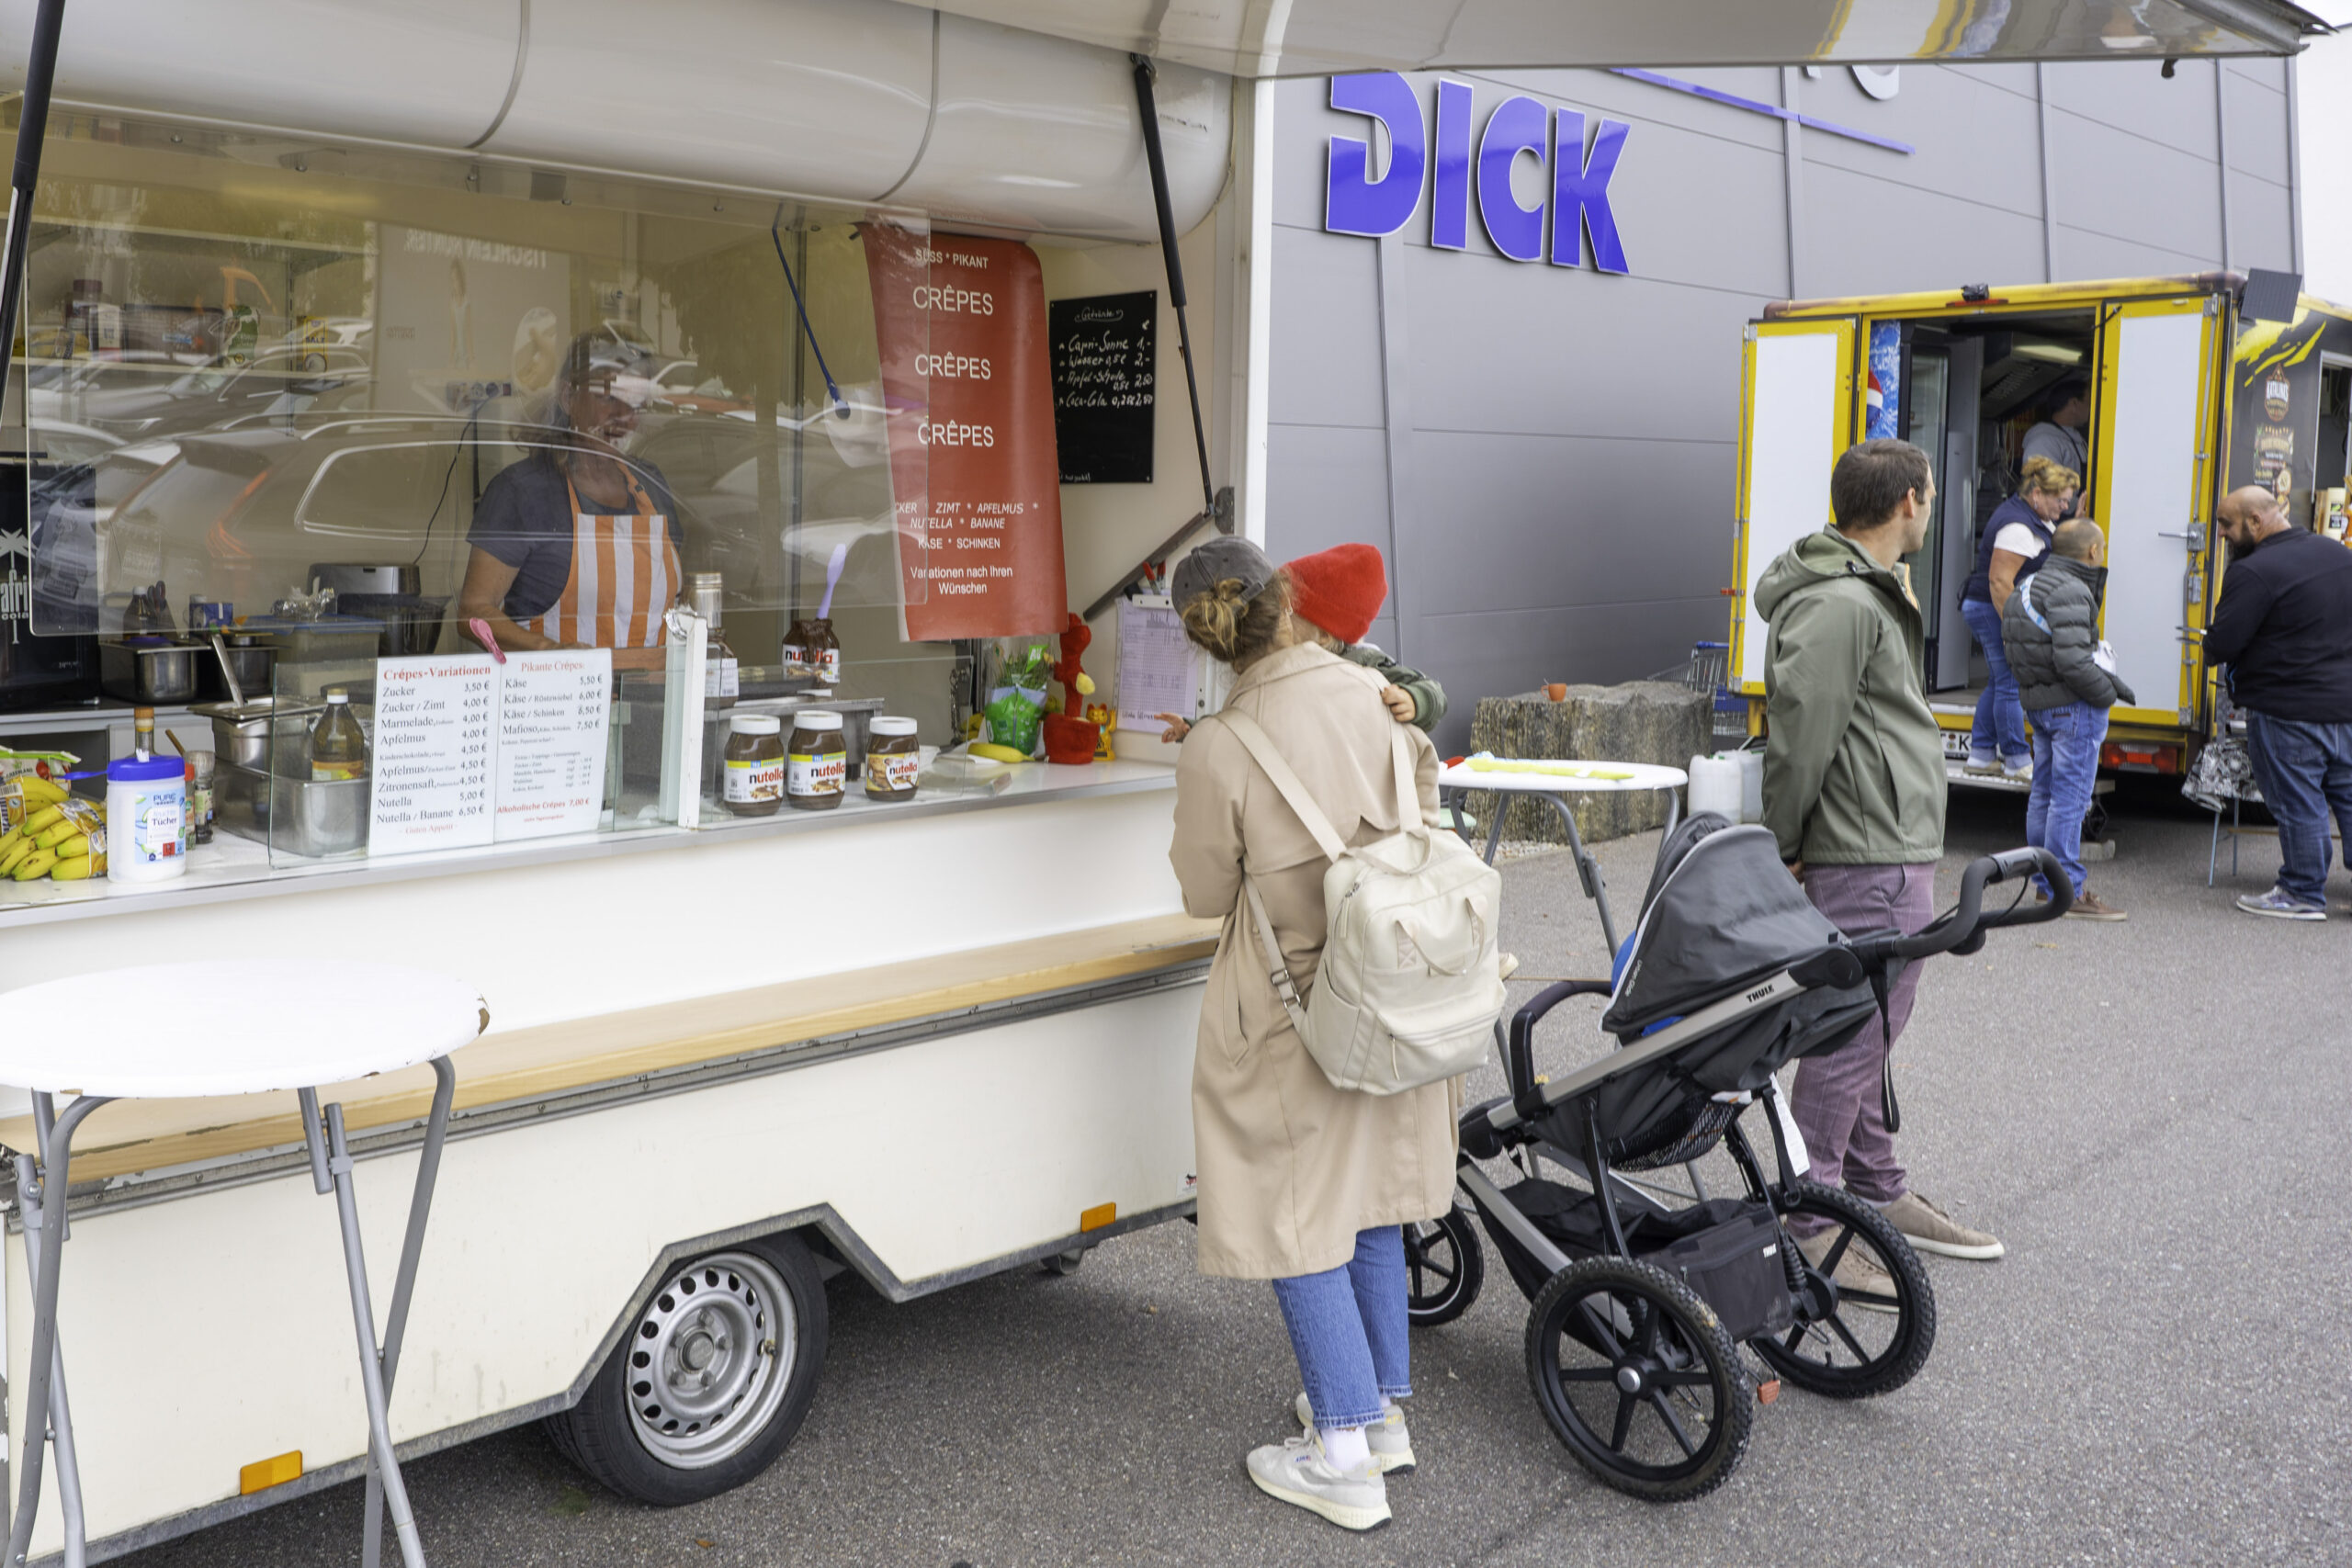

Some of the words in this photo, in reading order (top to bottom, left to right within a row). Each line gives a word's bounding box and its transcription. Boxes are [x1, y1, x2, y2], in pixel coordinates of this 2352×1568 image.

[1325, 71, 1631, 276] DICK
[953, 253, 989, 269] PIKANT
[913, 284, 993, 316] CRÊPES
[1069, 330, 1129, 356] Capri-Sonne
[915, 351, 991, 380] CRÊPES
[1066, 390, 1108, 408] Coca-Cola
[918, 420, 994, 447] CRÊPES
[935, 502, 961, 514] ZIMT
[977, 502, 1023, 514] APFELMUS
[970, 517, 1005, 529] BANANE
[956, 537, 1001, 549] SCHINKEN
[967, 565, 989, 578] nach
[989, 565, 1013, 578] Ihren
[0, 569, 29, 614] afri
[938, 581, 988, 595] Wünschen
[521, 661, 553, 672] Pikante
[382, 686, 416, 697] Zucker
[464, 682, 482, 693] 3,50
[483, 680, 490, 691] €
[505, 678, 527, 689] Käse
[580, 675, 595, 685] 5,50
[597, 673, 603, 683] €
[381, 703, 415, 714] Zucker
[423, 700, 446, 711] Zimt
[462, 698, 481, 708] 4,00
[482, 696, 489, 706] €
[504, 694, 526, 705] Käse
[579, 691, 595, 702] 6,00
[597, 689, 603, 699] €
[462, 714, 481, 724] 4,00
[482, 711, 489, 721] €
[503, 709, 526, 719] Käse
[533, 708, 565, 717] Schinken
[596, 704, 602, 714] €
[577, 720, 594, 731] 7,50
[594, 718, 600, 728] €
[380, 734, 426, 747] Apfelmus
[461, 729, 480, 740] 4,00
[481, 727, 488, 737] €
[461, 745, 479, 756] 4,50
[481, 742, 487, 752] €
[460, 760, 479, 771] 4,50
[481, 758, 487, 768] €
[810, 761, 846, 778] nutella
[889, 763, 918, 775] nutella
[459, 775, 478, 786] 4,50
[480, 773, 486, 784] €
[749, 768, 784, 784] nutella
[378, 796, 412, 808] Nutella
[459, 791, 478, 801] 5,00
[480, 788, 485, 798] €
[497, 802, 541, 814] Alkoholische
[569, 798, 584, 807] 7,00
[151, 817, 177, 827] Tücher
[377, 812, 411, 824] Nutella
[420, 809, 454, 820] Banane
[458, 807, 477, 817] 6,50
[479, 804, 484, 814] €
[1747, 984, 1775, 1003] THULE
